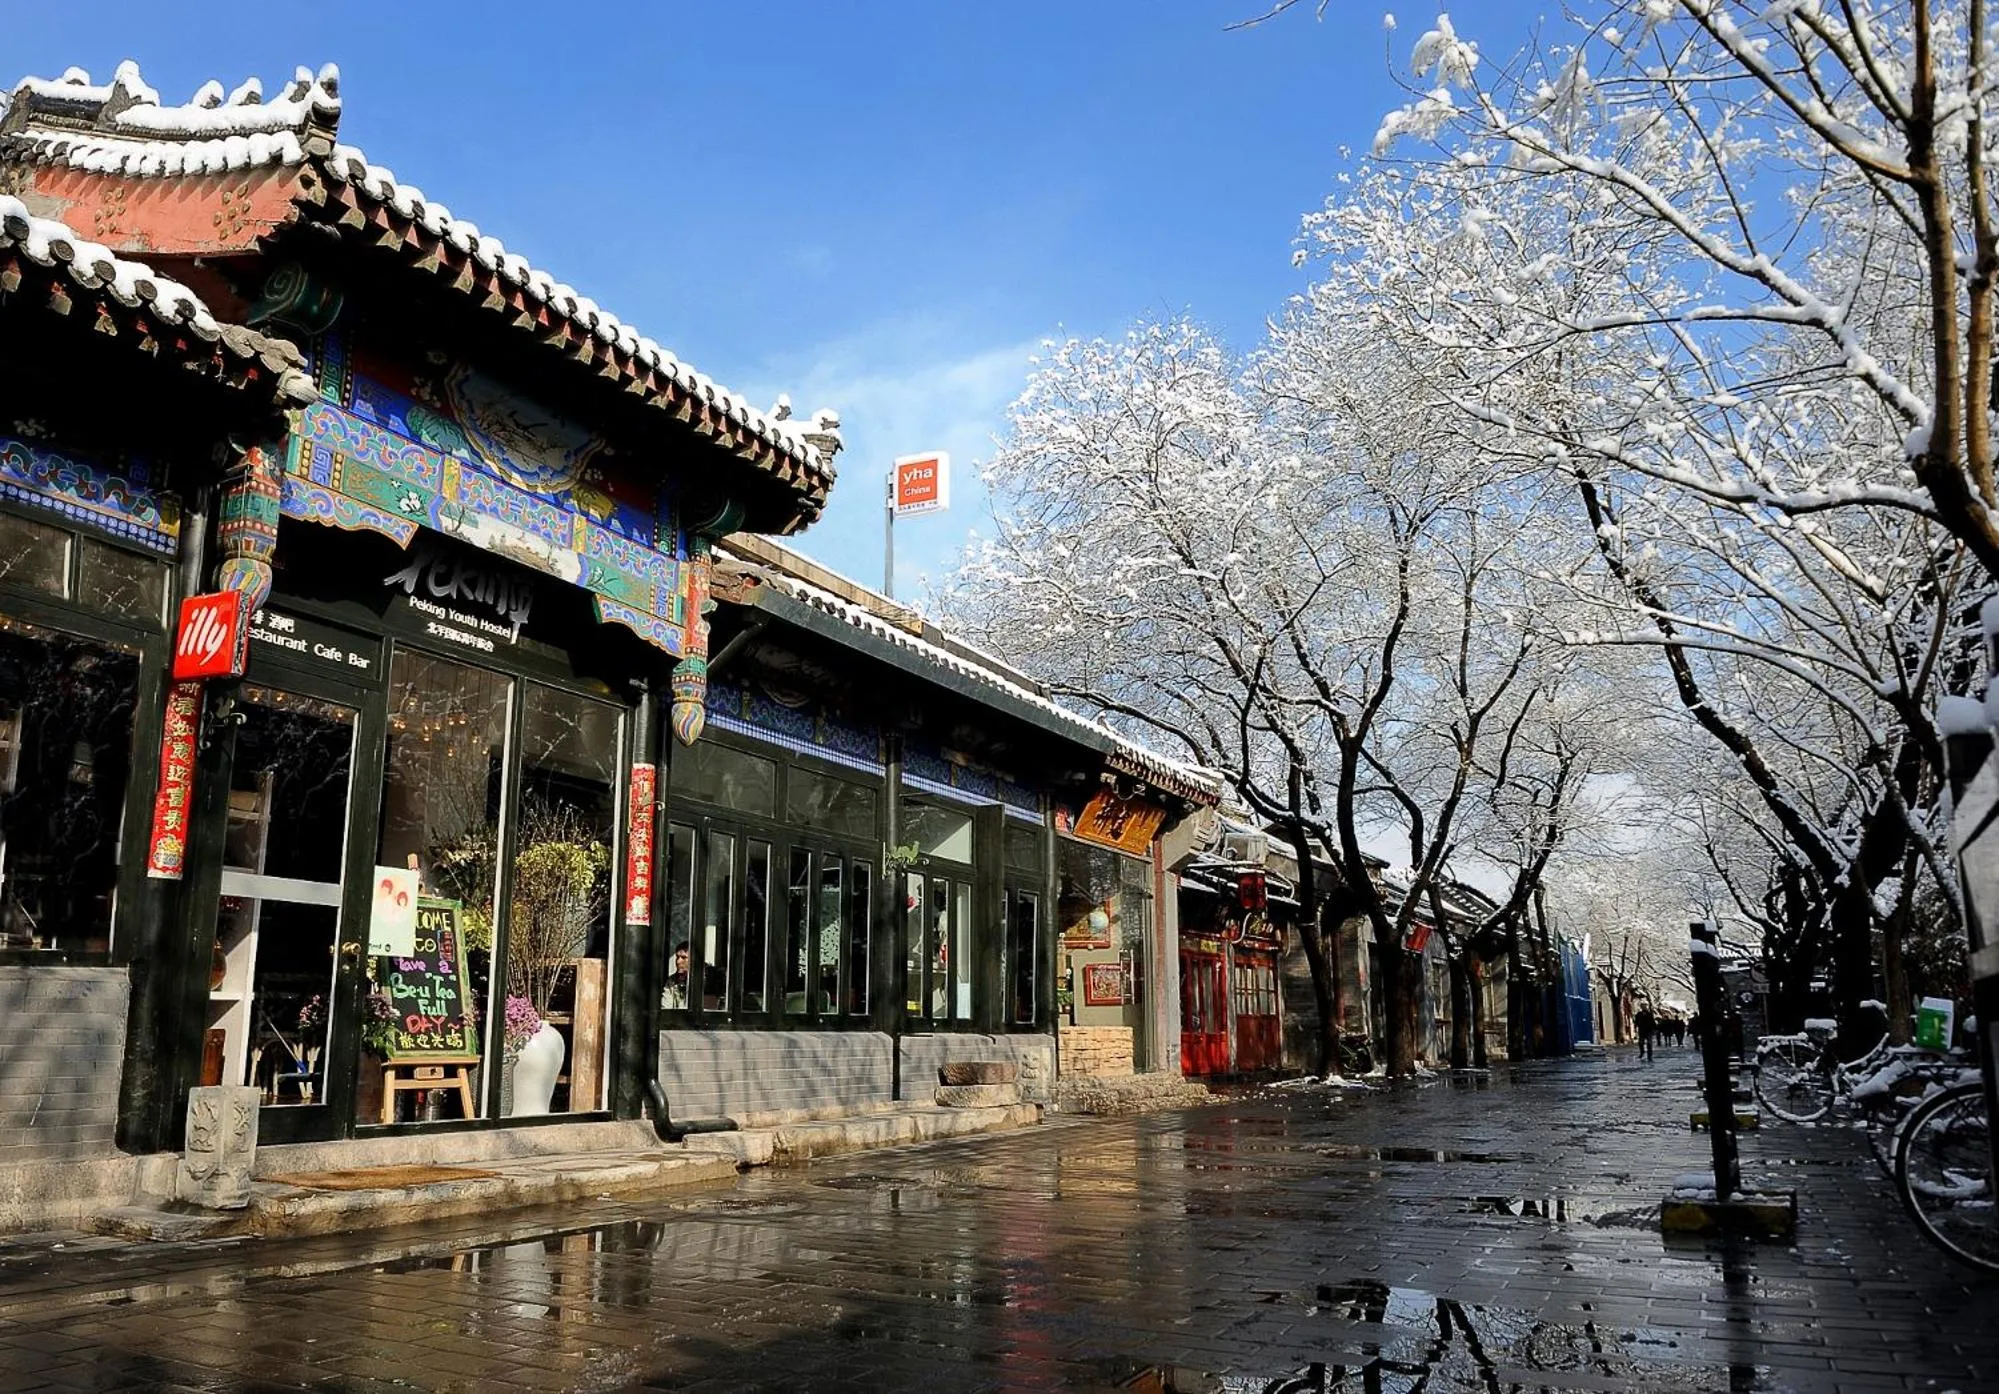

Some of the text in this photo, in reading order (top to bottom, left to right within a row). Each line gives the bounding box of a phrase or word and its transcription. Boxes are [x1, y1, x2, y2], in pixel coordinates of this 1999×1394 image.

[903, 467, 933, 485] yha
[409, 595, 511, 638] Peking Youth Hostel
[178, 606, 228, 666] illy
[247, 627, 371, 669] estaurant Cafe Bar
[415, 909, 452, 931] COME
[417, 998, 449, 1017] Full
